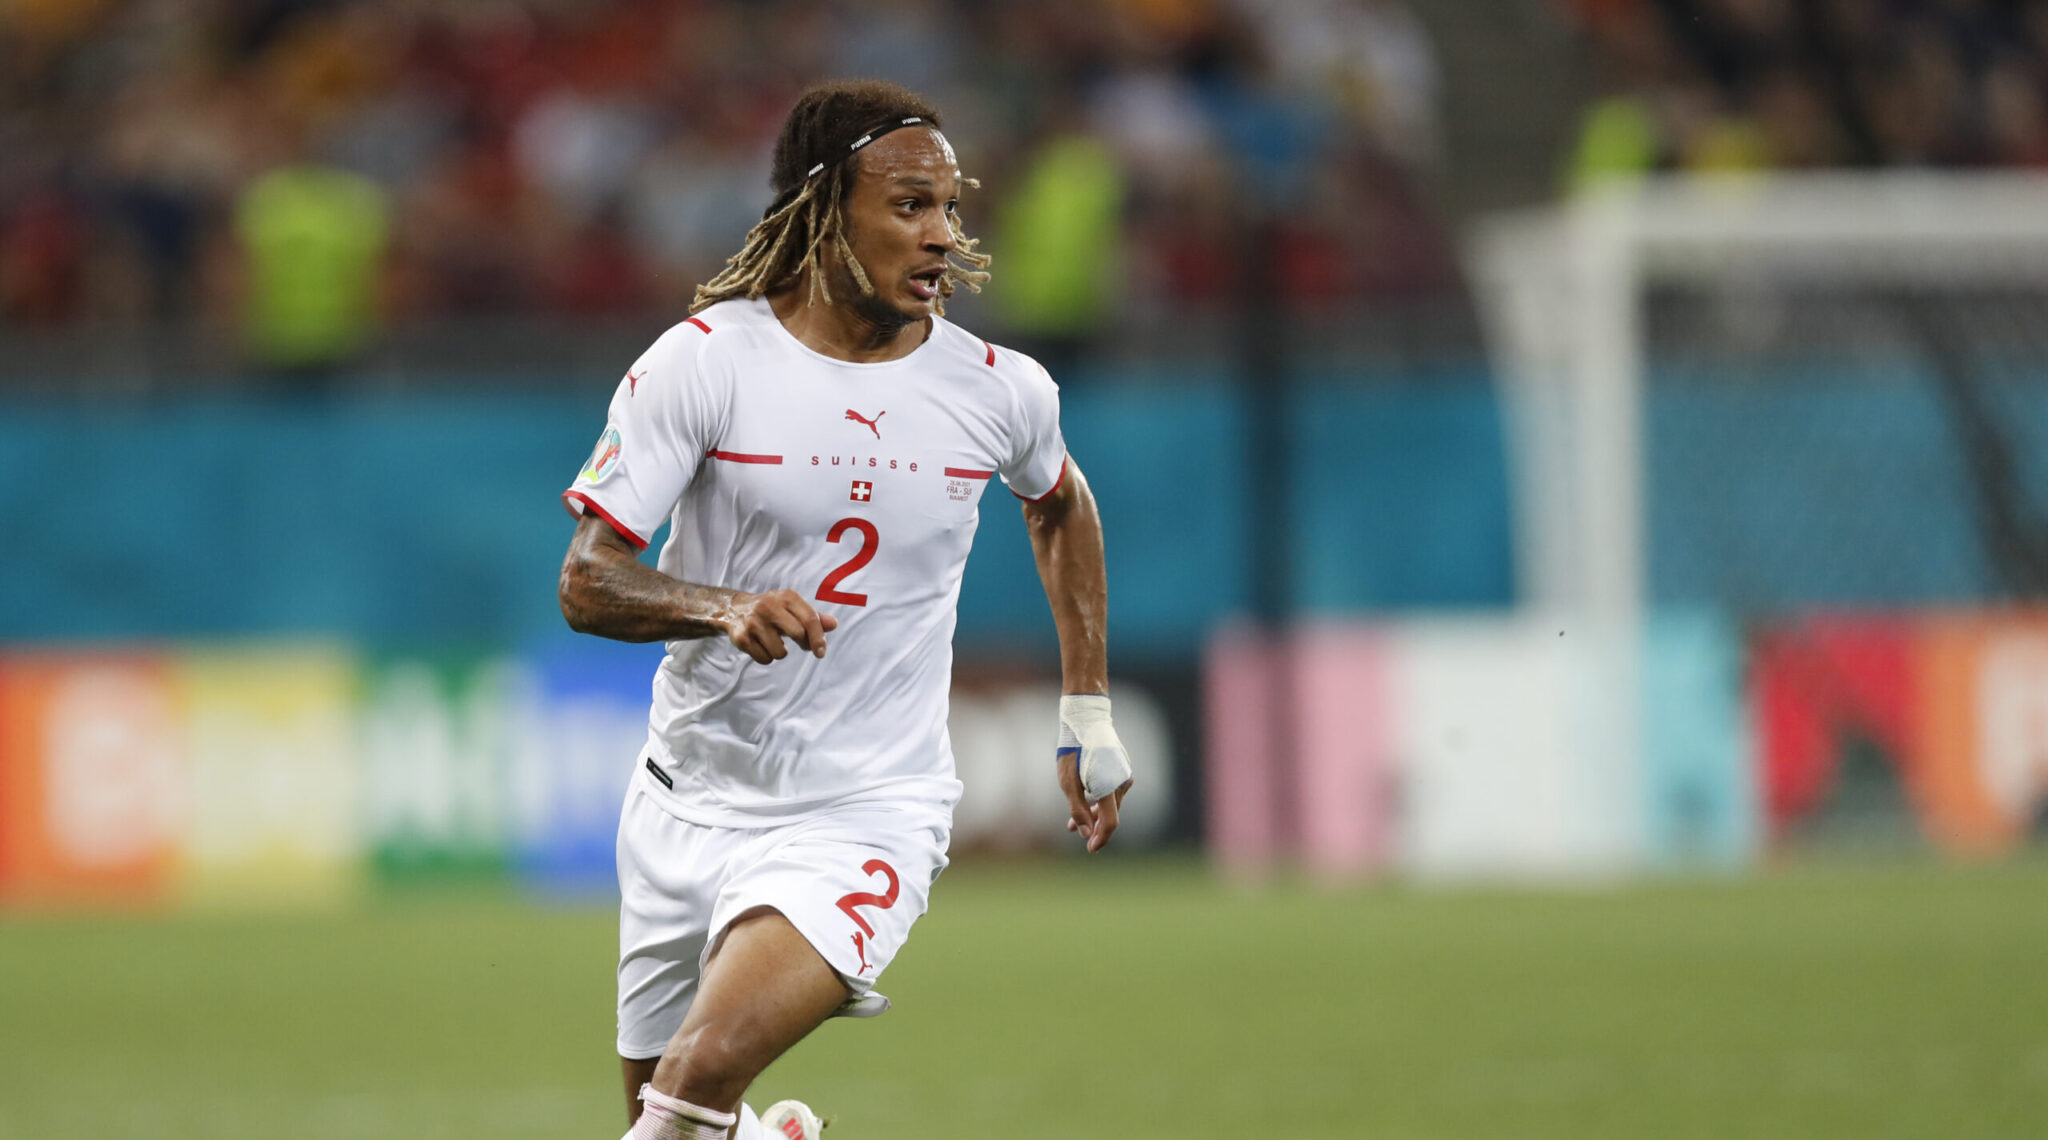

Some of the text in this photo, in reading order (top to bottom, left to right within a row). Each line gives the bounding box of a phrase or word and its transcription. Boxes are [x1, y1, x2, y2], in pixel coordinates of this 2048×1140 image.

[850, 134, 872, 151] PUMA
[815, 517, 879, 607] 2
[835, 858, 900, 941] 2
